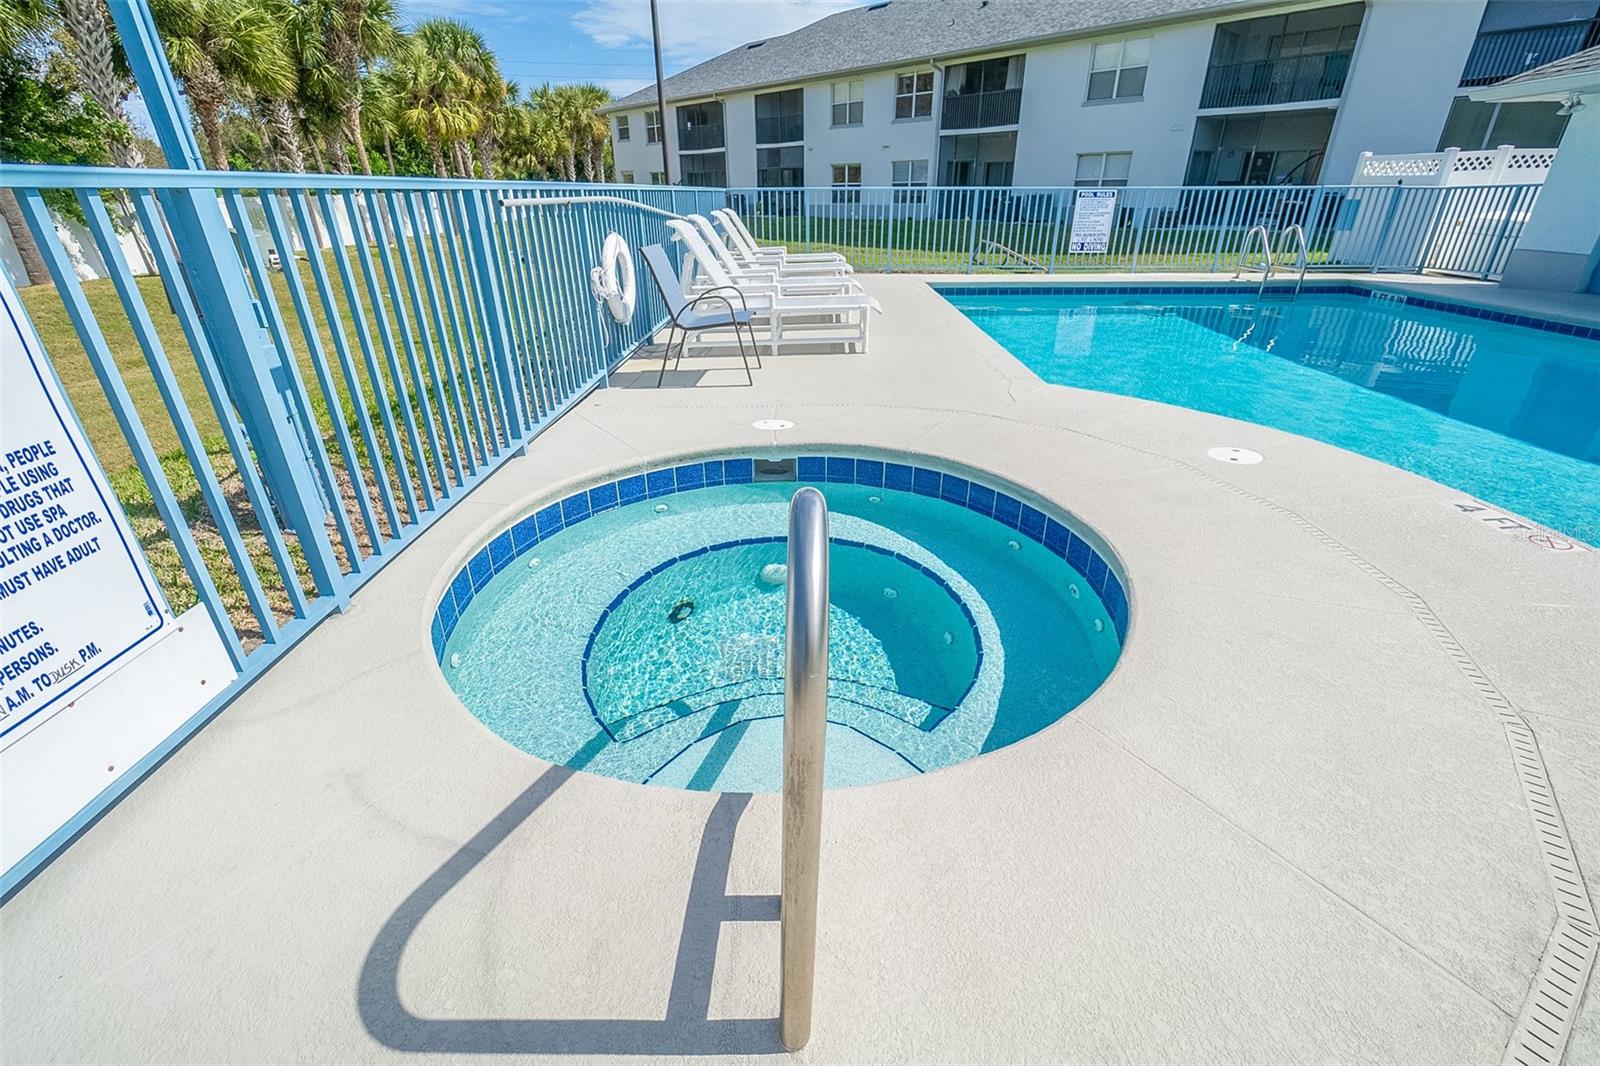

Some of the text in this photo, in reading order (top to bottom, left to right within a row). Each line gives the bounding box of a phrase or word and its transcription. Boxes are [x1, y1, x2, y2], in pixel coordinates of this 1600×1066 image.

[1071, 242, 1106, 251] NO DIVING
[5, 440, 57, 469] PEOPLE
[0, 476, 20, 495] LE
[17, 462, 59, 487] USING
[0, 477, 75, 519] DRUGS THAT
[14, 513, 44, 535] USE
[42, 504, 68, 524] SPA
[42, 532, 54, 547] A
[51, 511, 102, 542] DOCTOR.
[1454, 503, 1533, 531] 4 FT
[0, 537, 101, 600] MUST HAVE ADULT
[0, 642, 59, 686] PERSONS.
[78, 642, 102, 662] P.M.
[49, 658, 81, 684] DUSK
[5, 686, 34, 711] A.M.
[32, 673, 52, 691] TO
